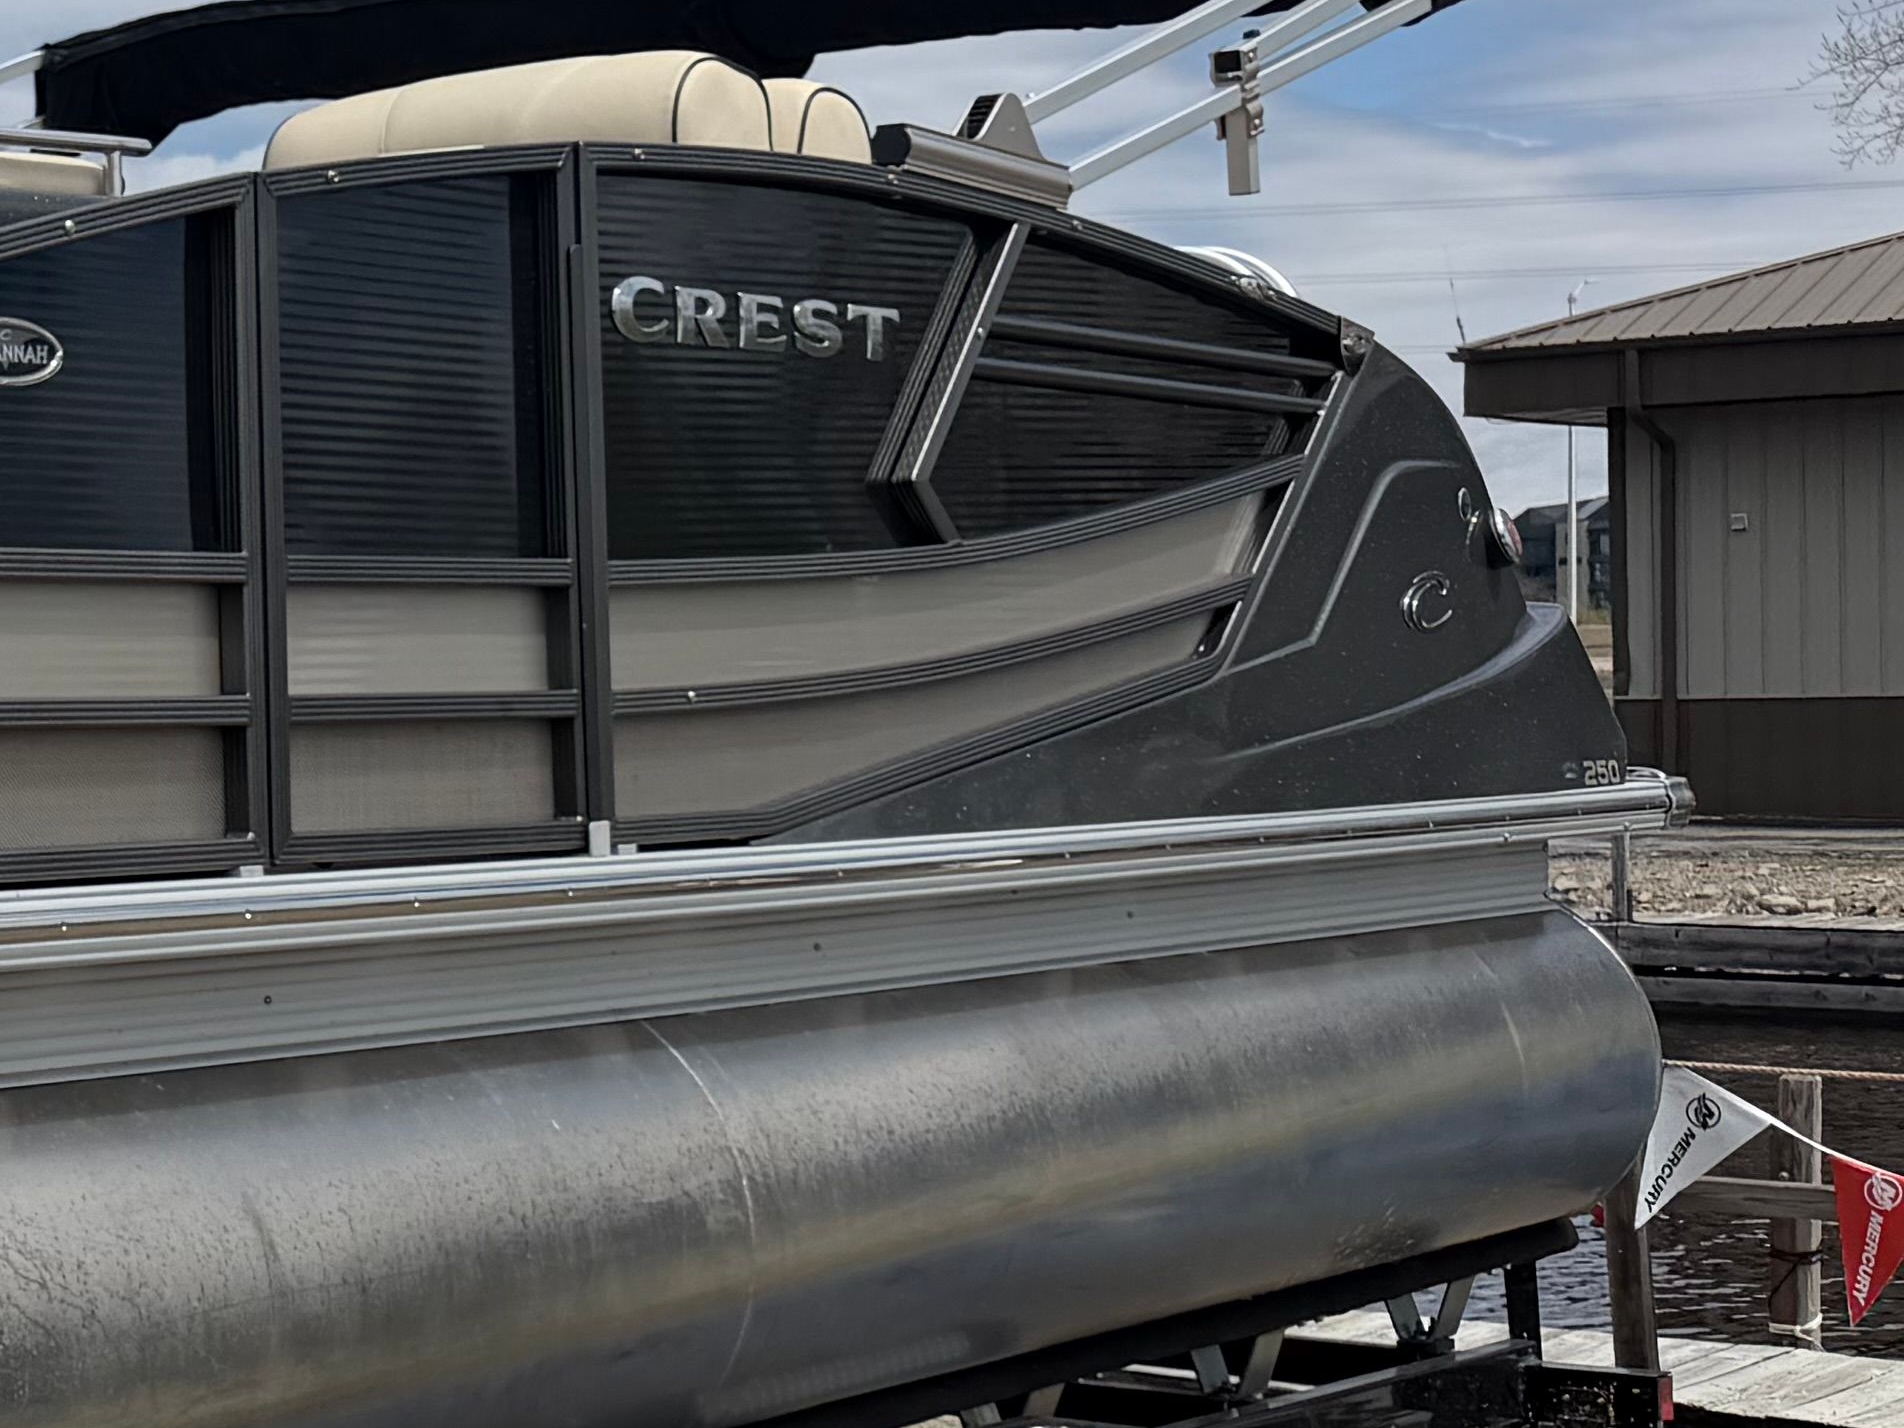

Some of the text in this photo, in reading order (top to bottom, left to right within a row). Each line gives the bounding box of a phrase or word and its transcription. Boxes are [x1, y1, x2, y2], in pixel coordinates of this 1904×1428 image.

[611, 275, 900, 362] CREST
[1582, 759, 1621, 786] 250
[1644, 1126, 1697, 1213] MERCURY
[1851, 1209, 1885, 1307] MERCURY
